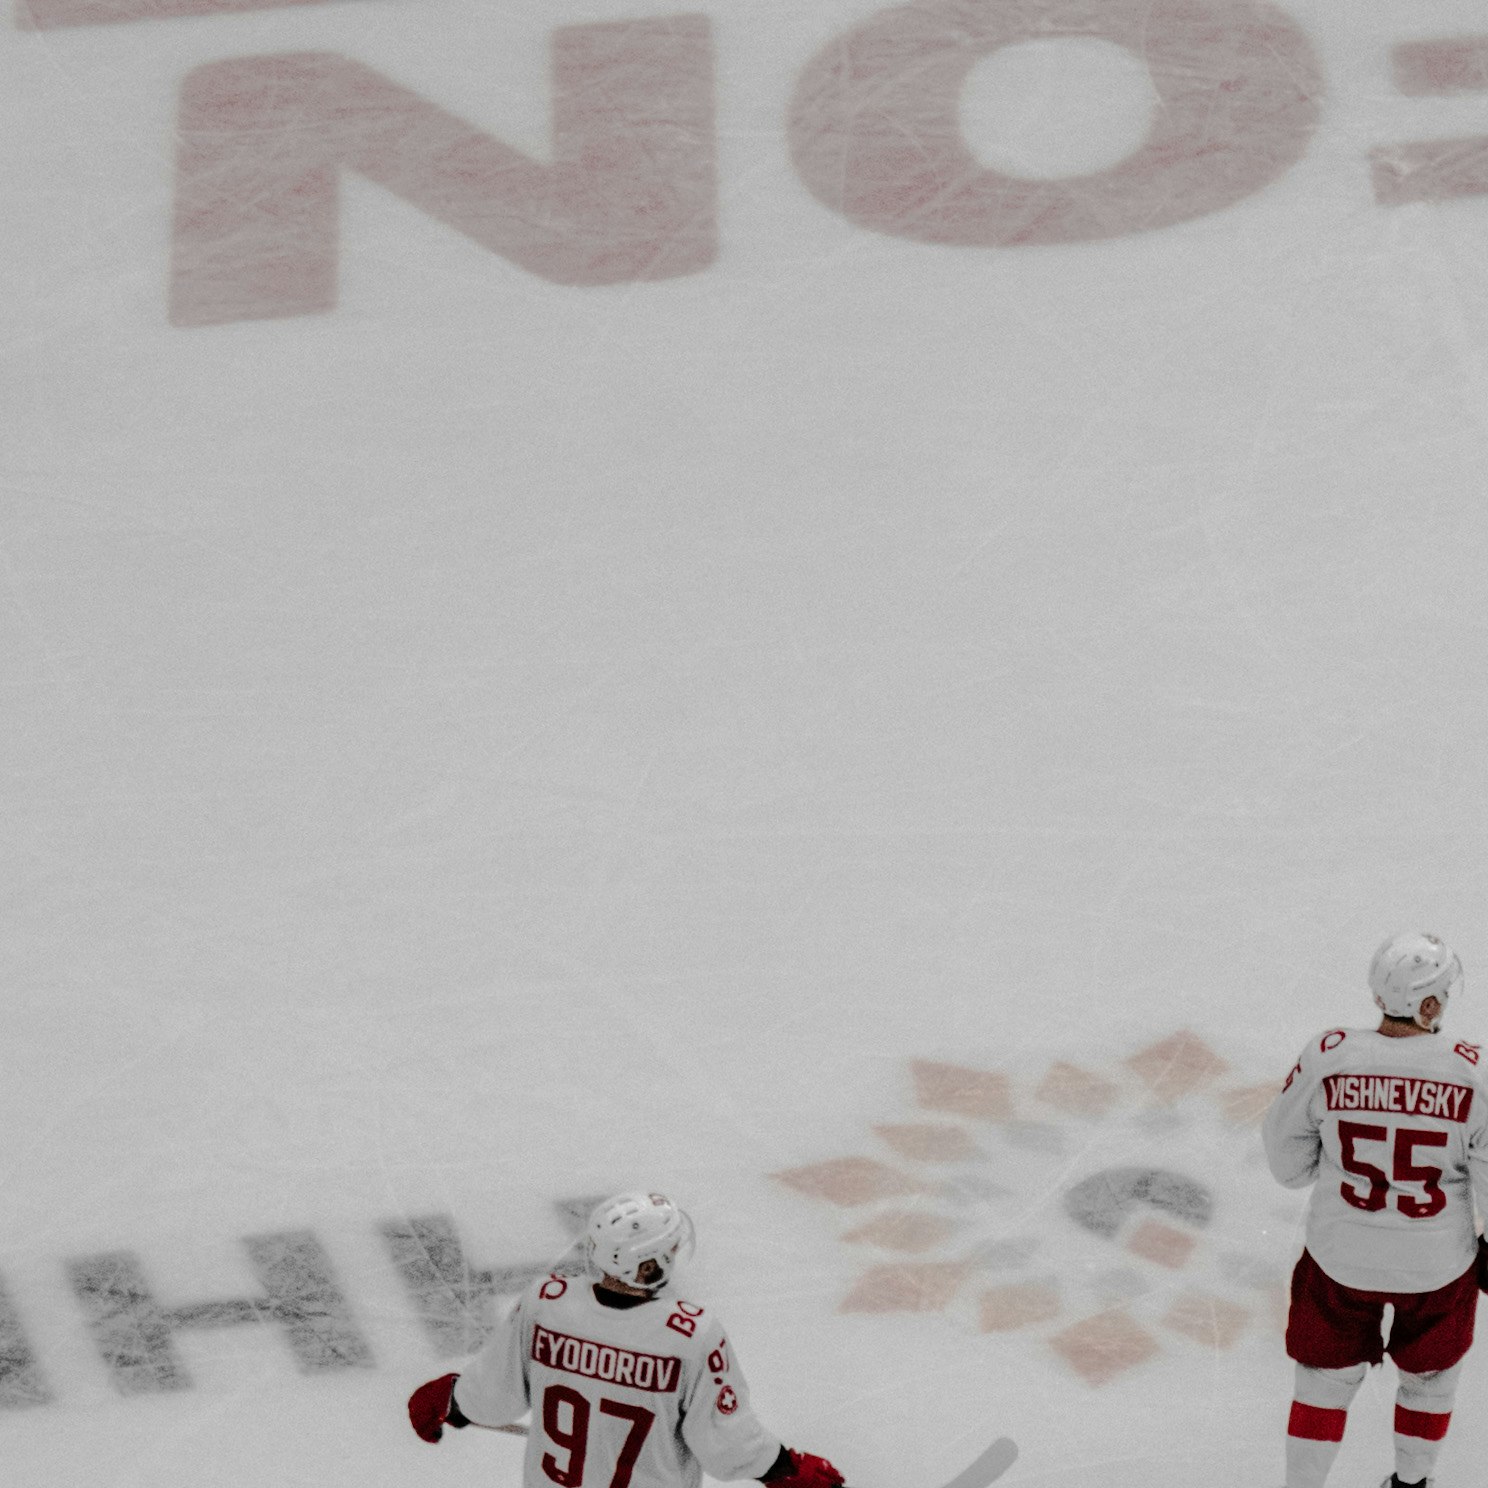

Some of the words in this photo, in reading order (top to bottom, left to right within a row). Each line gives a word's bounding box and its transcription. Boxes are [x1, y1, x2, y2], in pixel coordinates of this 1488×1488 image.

[1329, 1078, 1467, 1119] VISHNEVSKY
[1338, 1119, 1448, 1219] 55
[535, 1327, 677, 1391] FYODOROV
